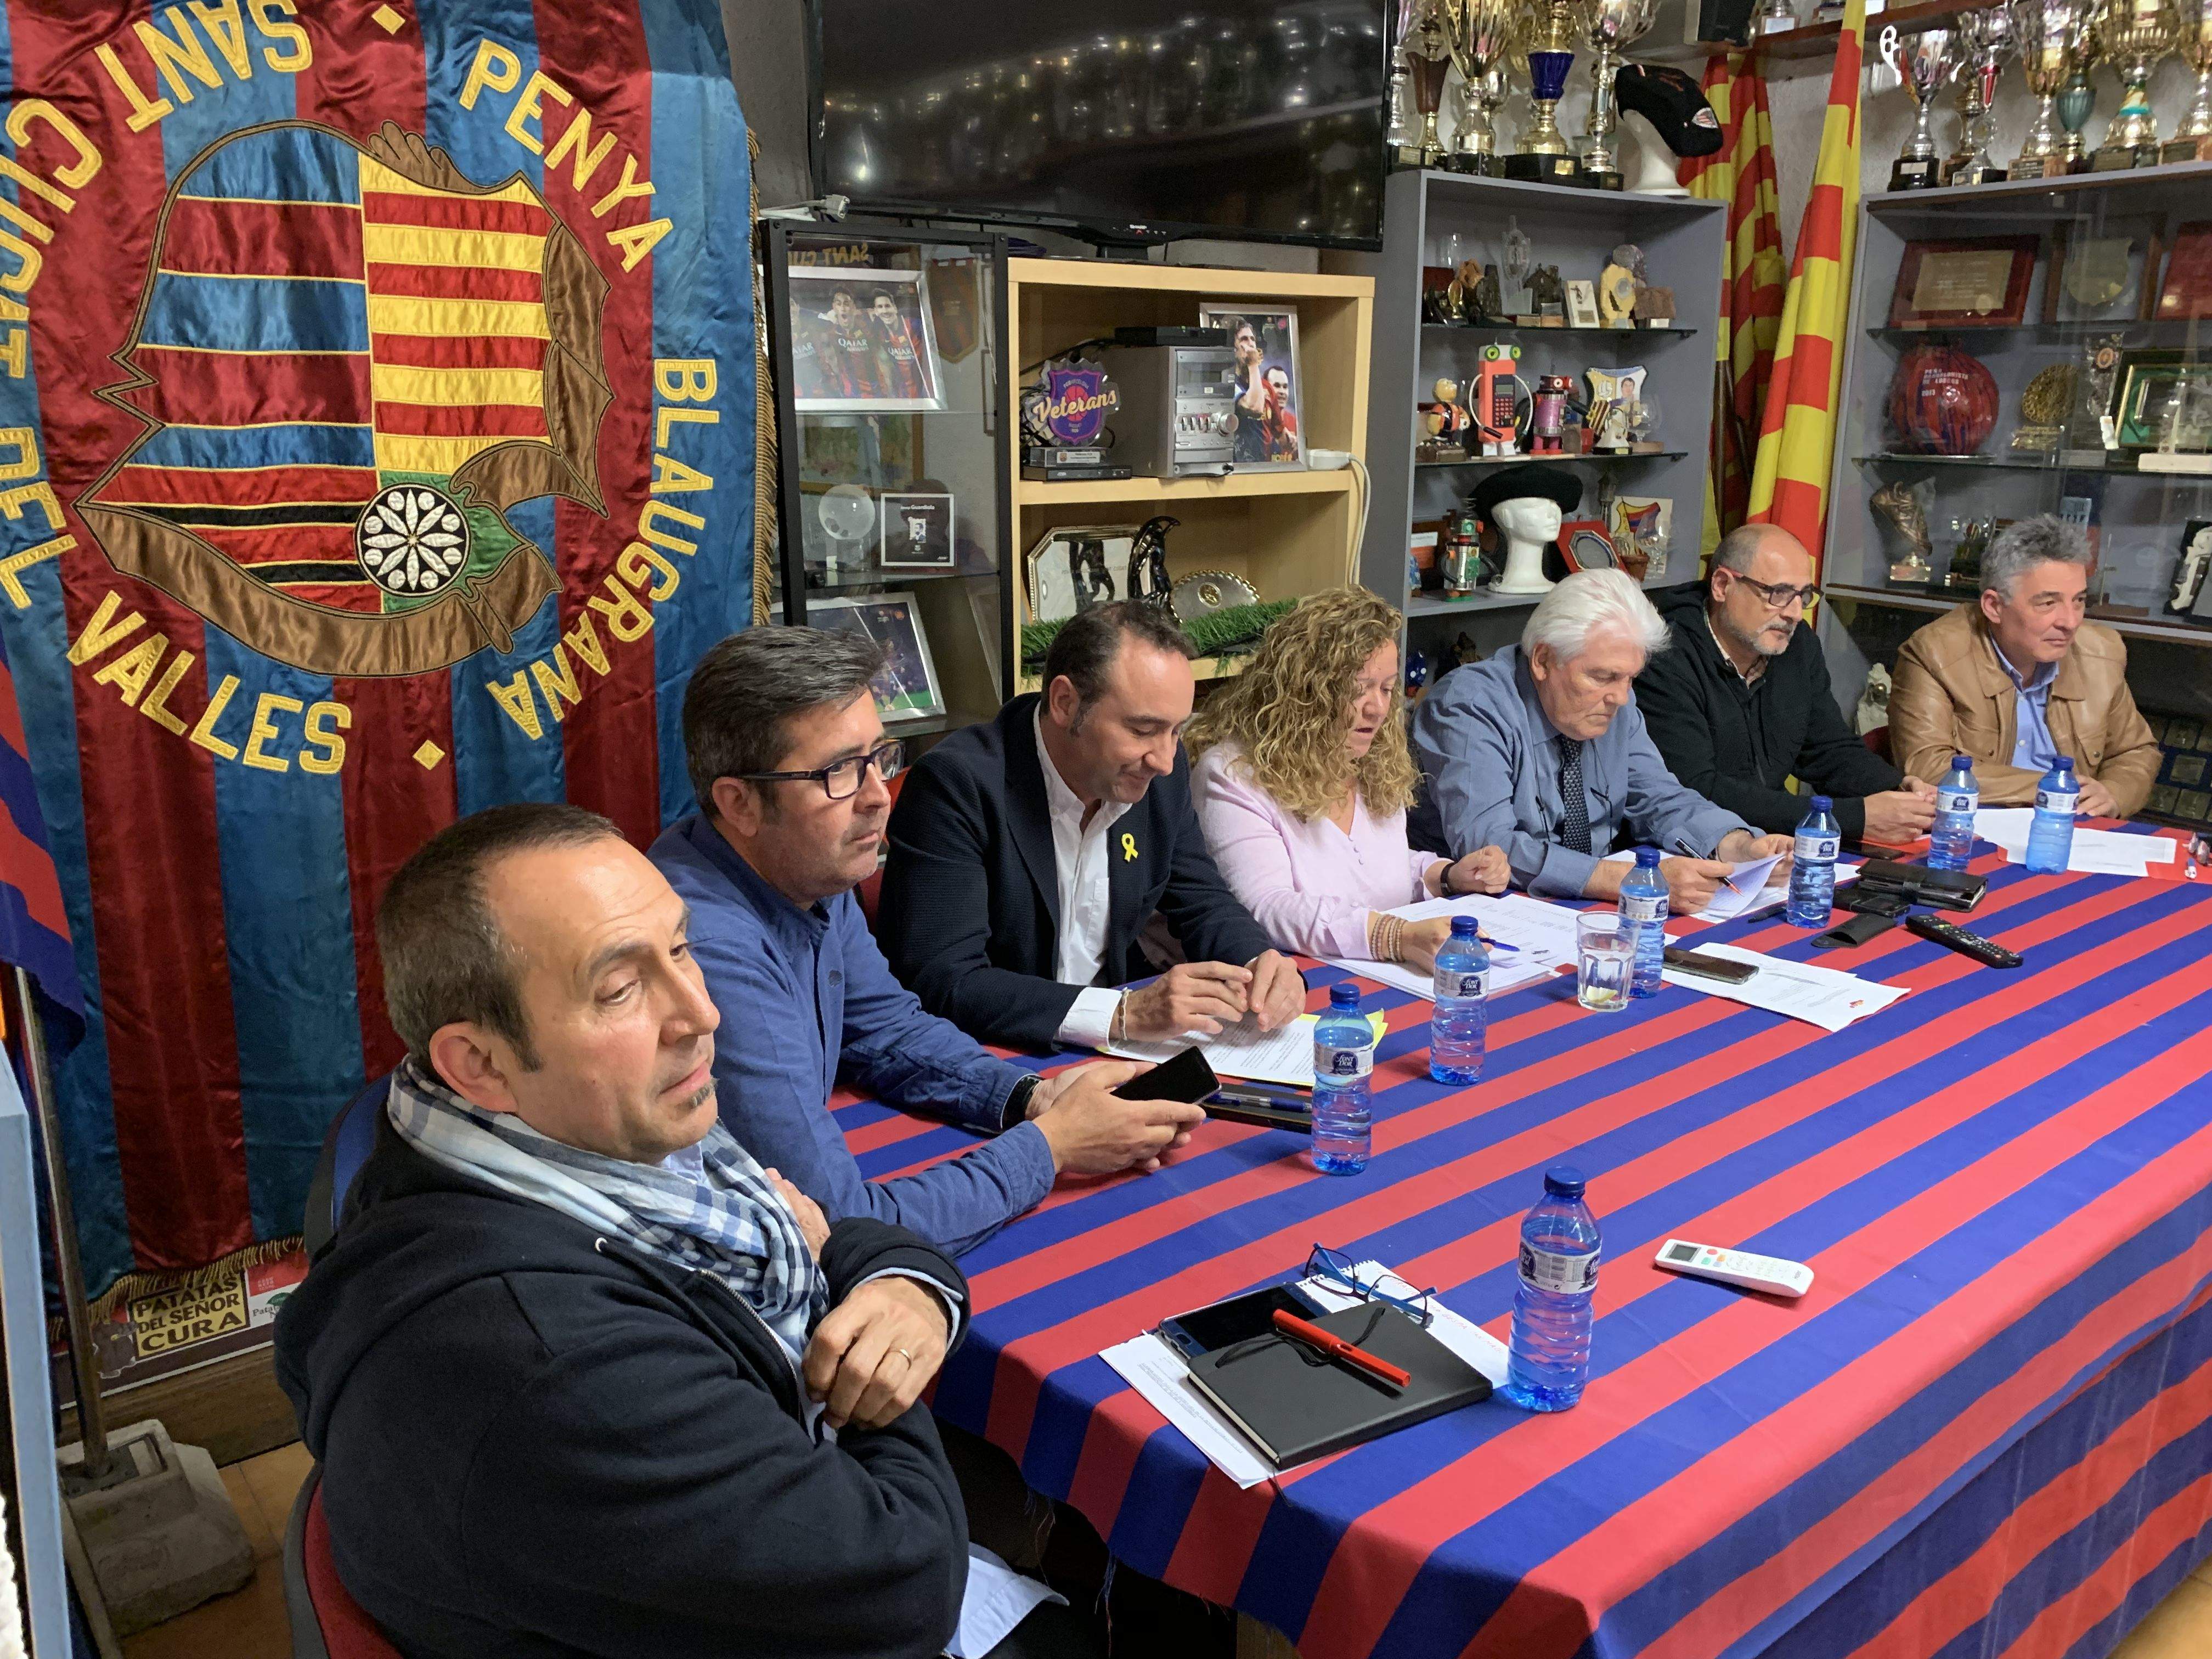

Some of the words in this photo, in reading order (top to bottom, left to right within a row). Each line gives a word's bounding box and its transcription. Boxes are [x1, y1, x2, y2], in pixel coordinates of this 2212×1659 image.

[94, 0, 313, 133] SANT
[461, 38, 674, 273] PENYA
[0, 98, 103, 379] CUT
[793, 341, 814, 355] ATAR
[838, 338, 868, 347] QATAR
[888, 347, 913, 356] QATAR
[1032, 390, 1117, 422] Veterans
[486, 358, 719, 741] BLAUGRANA
[65, 590, 352, 775] VALLES
[136, 1276, 239, 1318] PATATAS
[138, 1318, 167, 1334] DEL
[170, 1293, 240, 1324] SEÑOR
[141, 1312, 242, 1352] CURA
